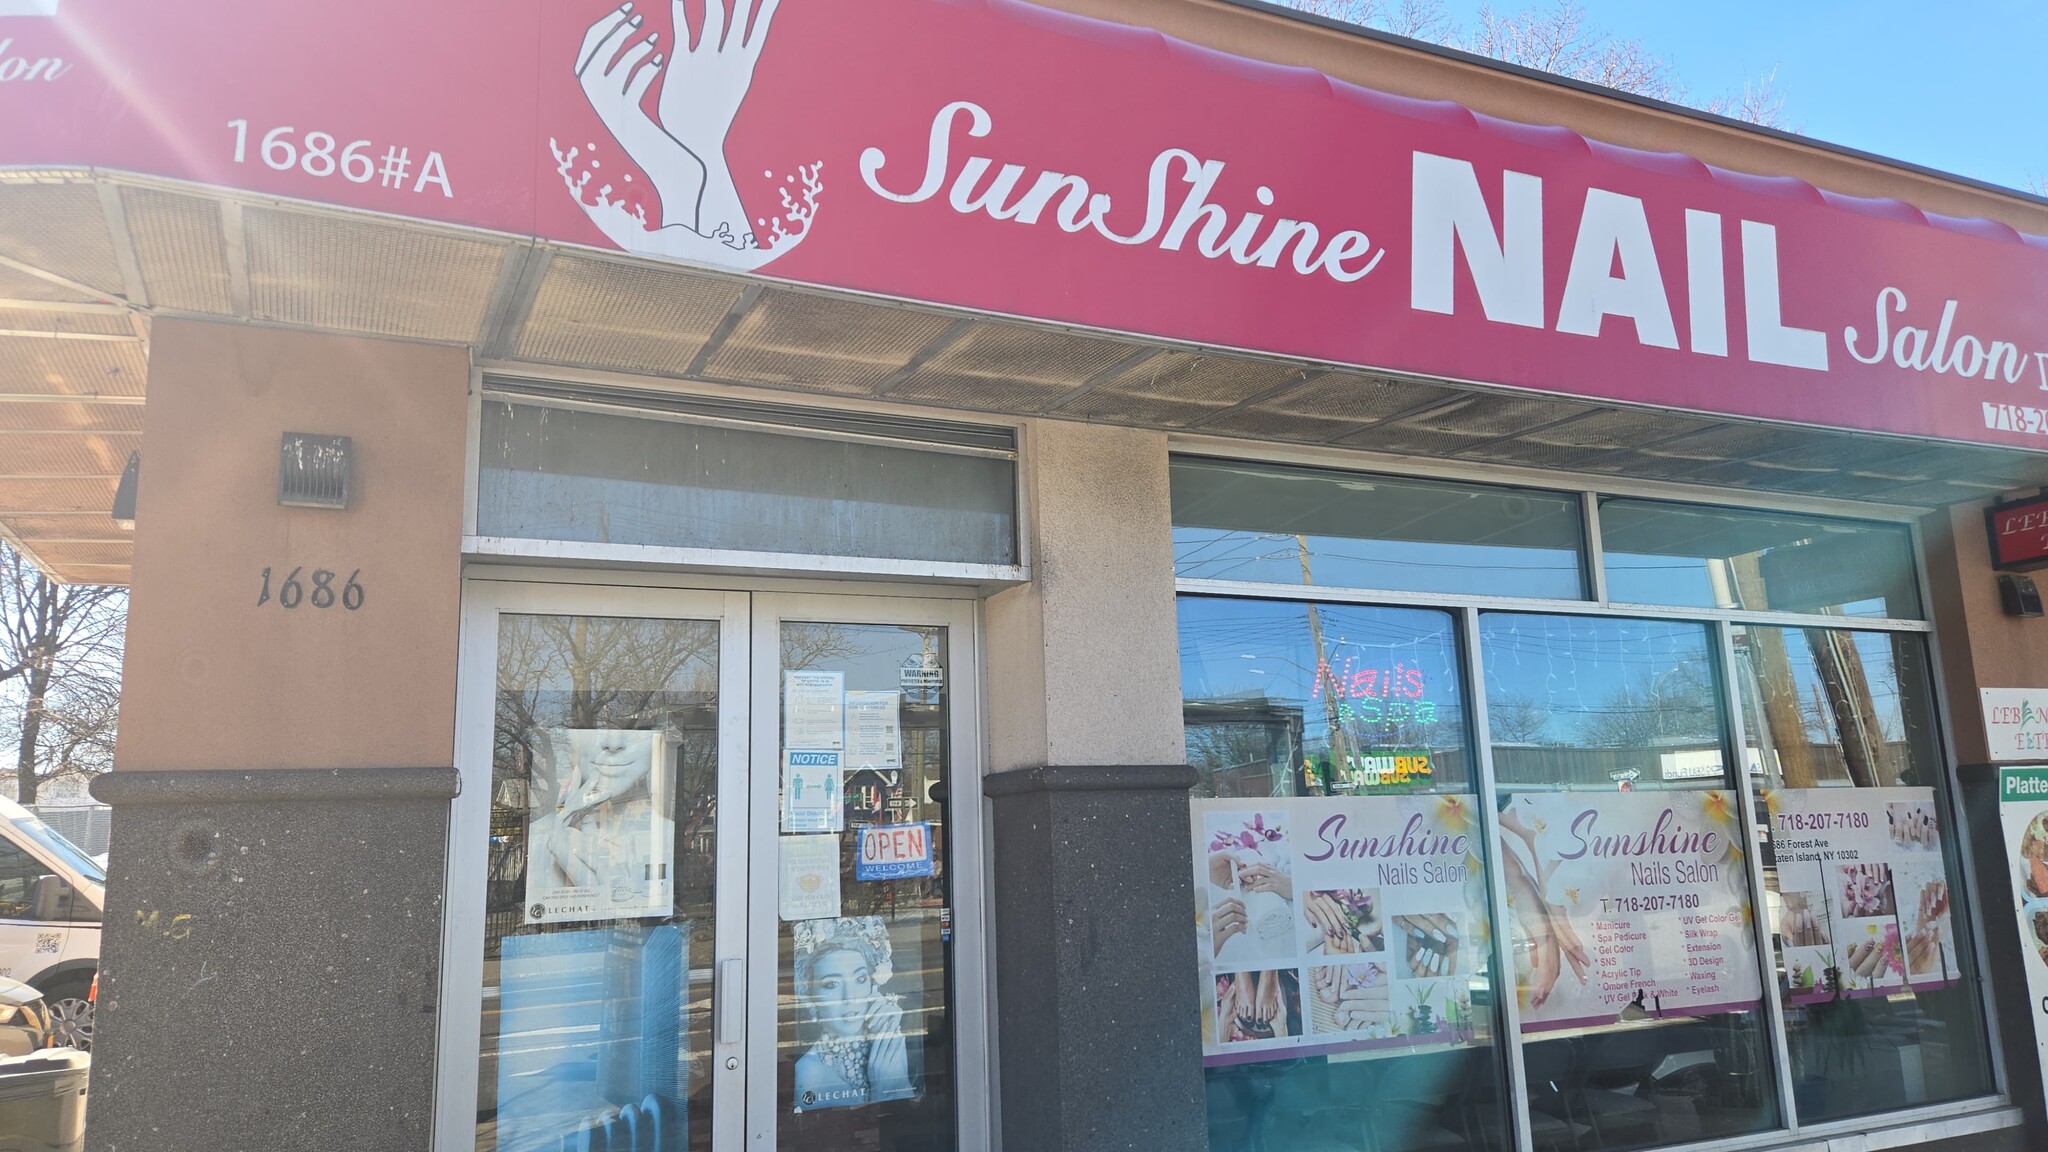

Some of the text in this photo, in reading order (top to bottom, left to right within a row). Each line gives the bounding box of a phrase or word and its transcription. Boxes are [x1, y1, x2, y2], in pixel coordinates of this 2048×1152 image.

[227, 118, 453, 198] 1686#A
[859, 101, 1384, 282] SunShine
[1411, 150, 1829, 371] NAIL
[1844, 287, 2028, 383] Salon
[1988, 402, 2048, 434] 718-2
[257, 566, 364, 611] 1686
[904, 669, 939, 678] WARNING
[1311, 657, 1424, 699] Nails
[1359, 697, 1438, 732] Spa
[792, 754, 836, 764] NOTICE
[2006, 776, 2048, 794] Platte
[1778, 812, 1869, 831] 718-207-7180
[1304, 813, 1471, 861] Sunshine
[1557, 808, 1720, 860] Sunshine
[865, 829, 923, 861] OPEN
[1787, 839, 1813, 849] Forest
[1814, 838, 1829, 848] Ave
[1823, 850, 1835, 861] NY
[1836, 850, 1859, 860] 10302
[865, 862, 923, 872] WELCOME
[1378, 862, 1469, 885] Nails Salon
[1632, 861, 1718, 886] Nails Salon
[548, 905, 589, 914] LECHAT
[1600, 894, 1699, 914] T. 718-207-7180
[1596, 921, 1631, 931] Manicure
[1683, 913, 1741, 925] UV Gel Color Gel
[1597, 931, 1647, 945] Spa Pedicure
[1684, 929, 1718, 939] Silk Wrap
[1599, 944, 1634, 955] Gel Color
[1686, 943, 1722, 953] Extension
[1600, 957, 1617, 967] SNS
[1688, 956, 1724, 966] 3D Design
[1601, 967, 1641, 981] Acrylic Tip
[1689, 971, 1716, 981] Waxing
[1603, 979, 1656, 991] Ombre French
[1691, 984, 1720, 996] Eyelash
[1604, 988, 1679, 1003] UV Gel Pk & White
